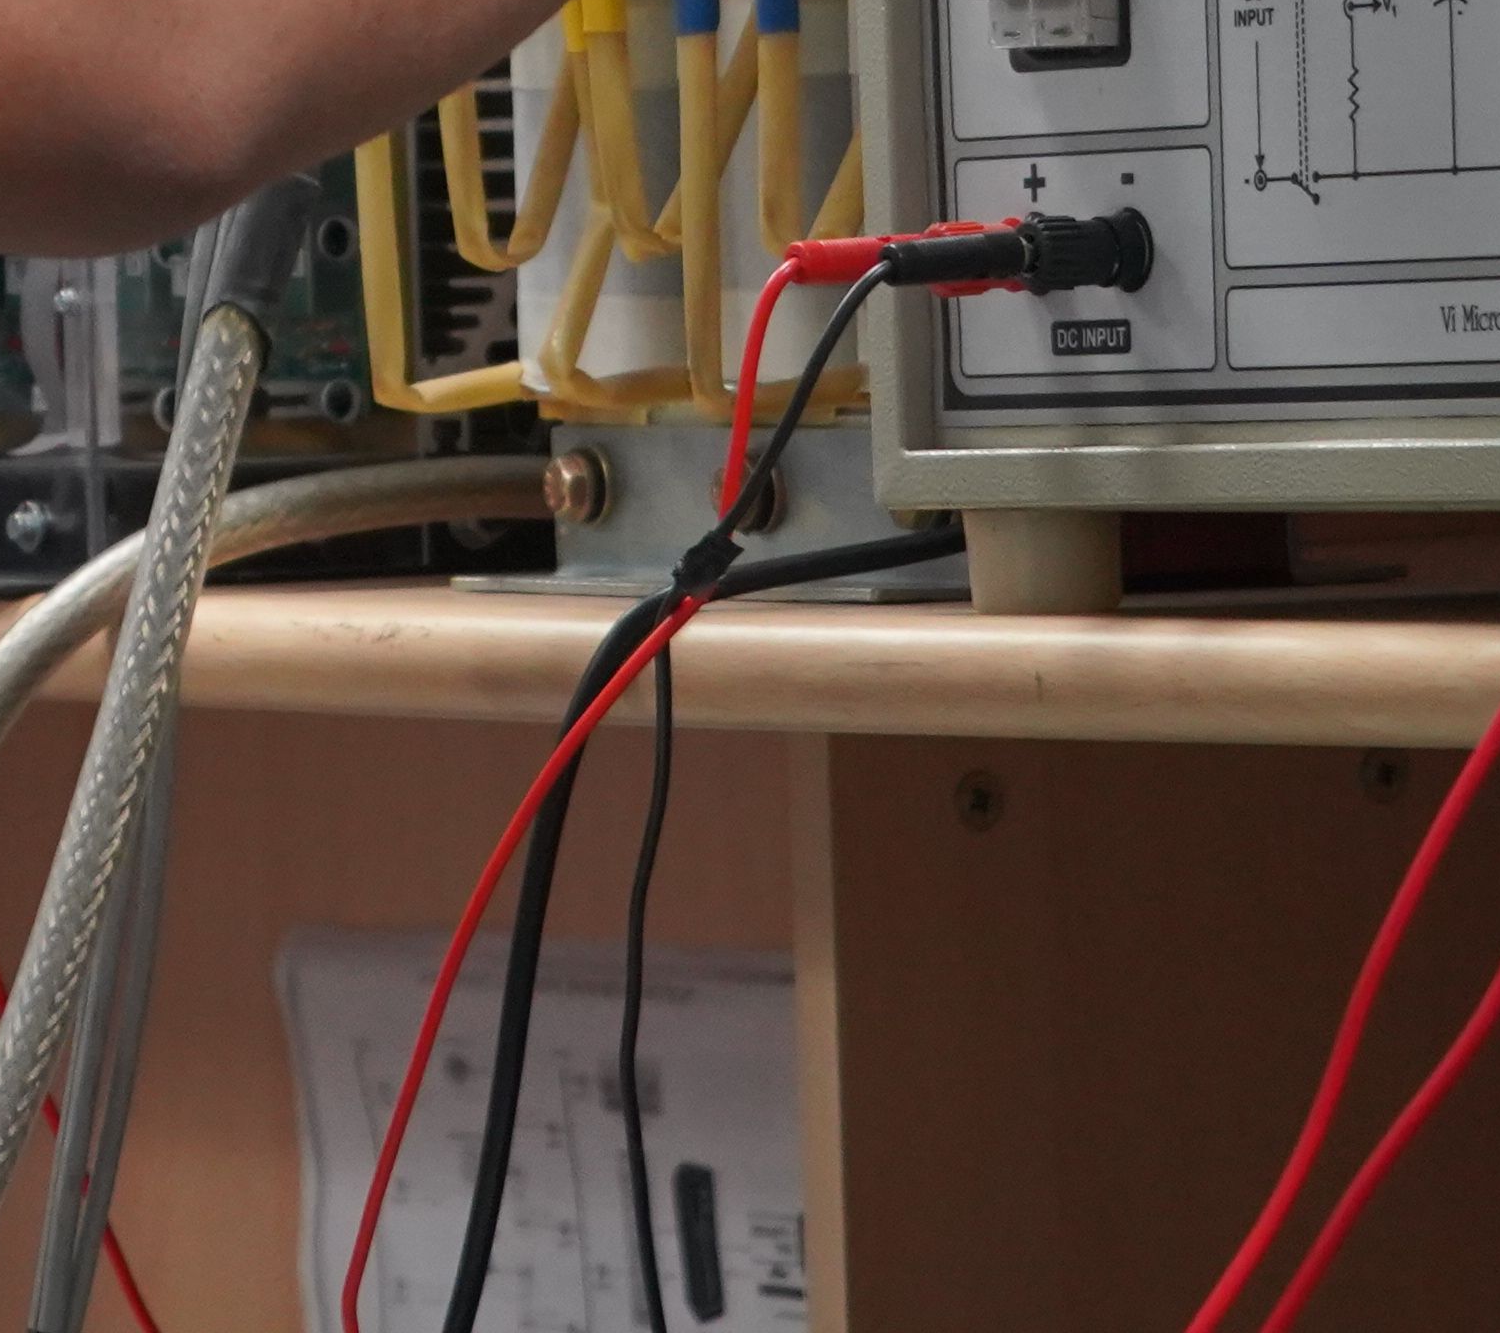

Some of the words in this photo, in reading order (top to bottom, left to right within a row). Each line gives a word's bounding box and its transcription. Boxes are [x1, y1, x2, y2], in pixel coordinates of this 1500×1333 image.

[1233, 8, 1275, 27] INPUT
[1440, 305, 1456, 333] Vi
[1057, 328, 1078, 348] DC
[1082, 326, 1126, 348] INPUT
